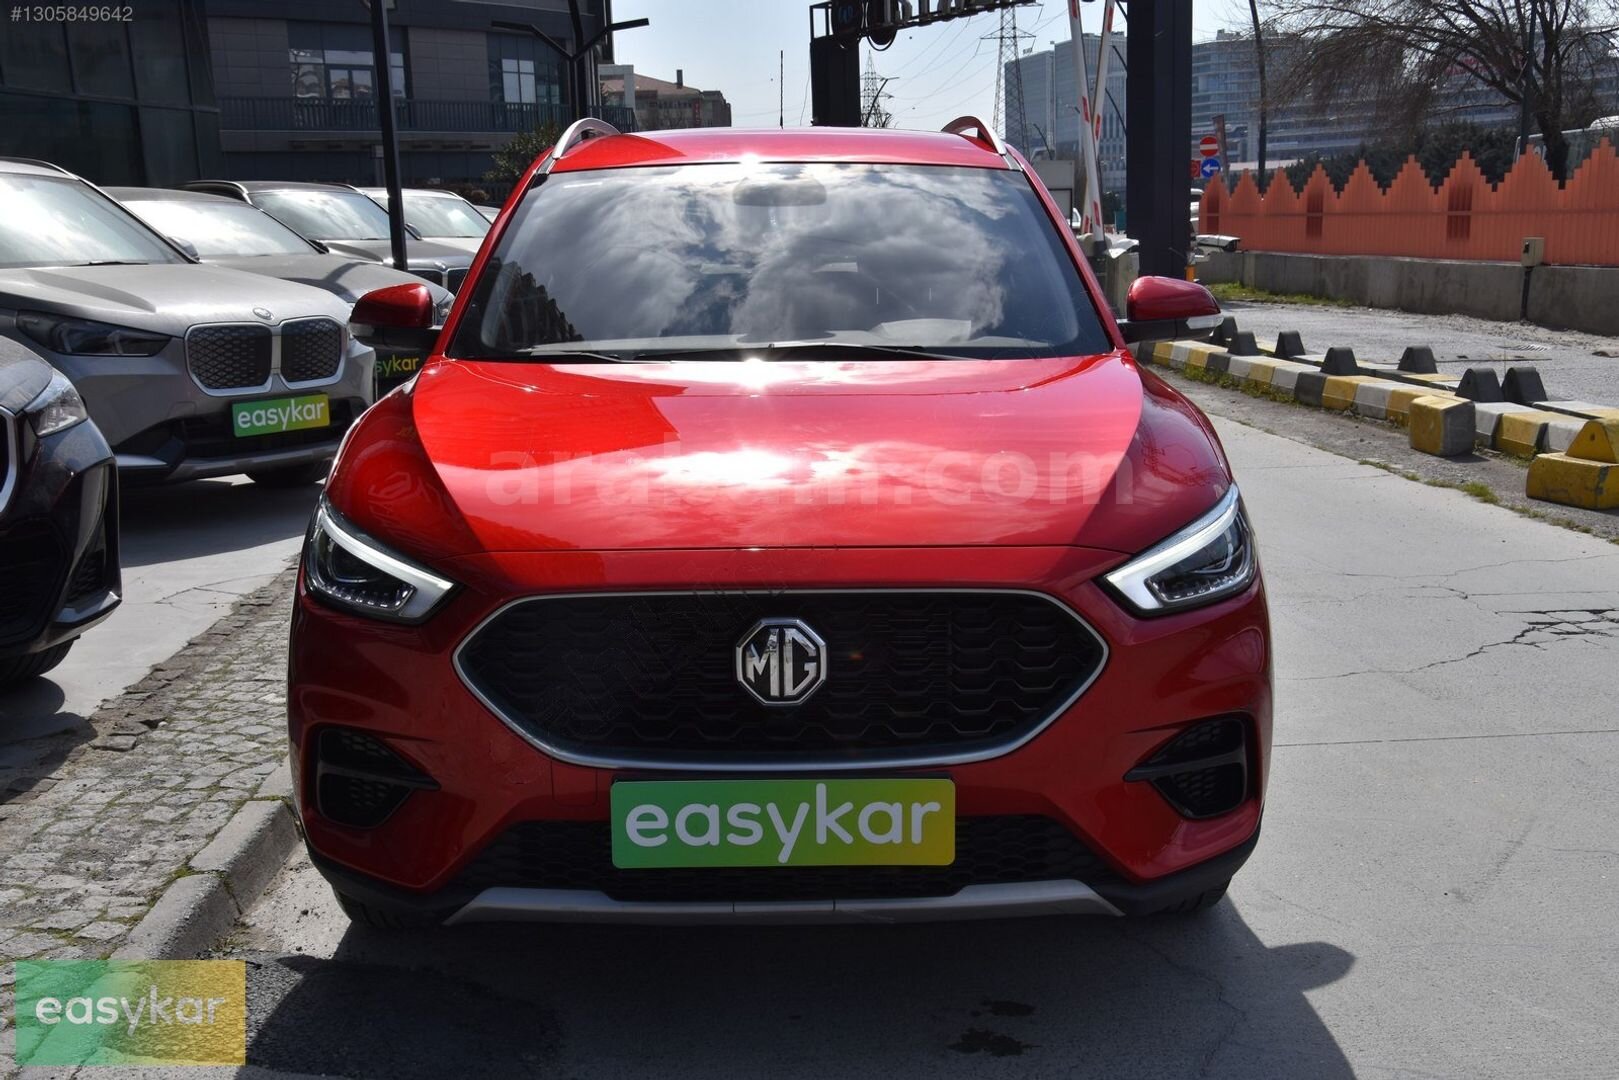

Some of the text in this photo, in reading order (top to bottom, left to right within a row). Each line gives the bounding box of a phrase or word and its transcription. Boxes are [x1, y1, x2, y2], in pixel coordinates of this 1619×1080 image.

[375, 354, 419, 377] sykar
[237, 398, 326, 431] easykar
[745, 627, 817, 697] MG
[625, 783, 942, 864] easykar
